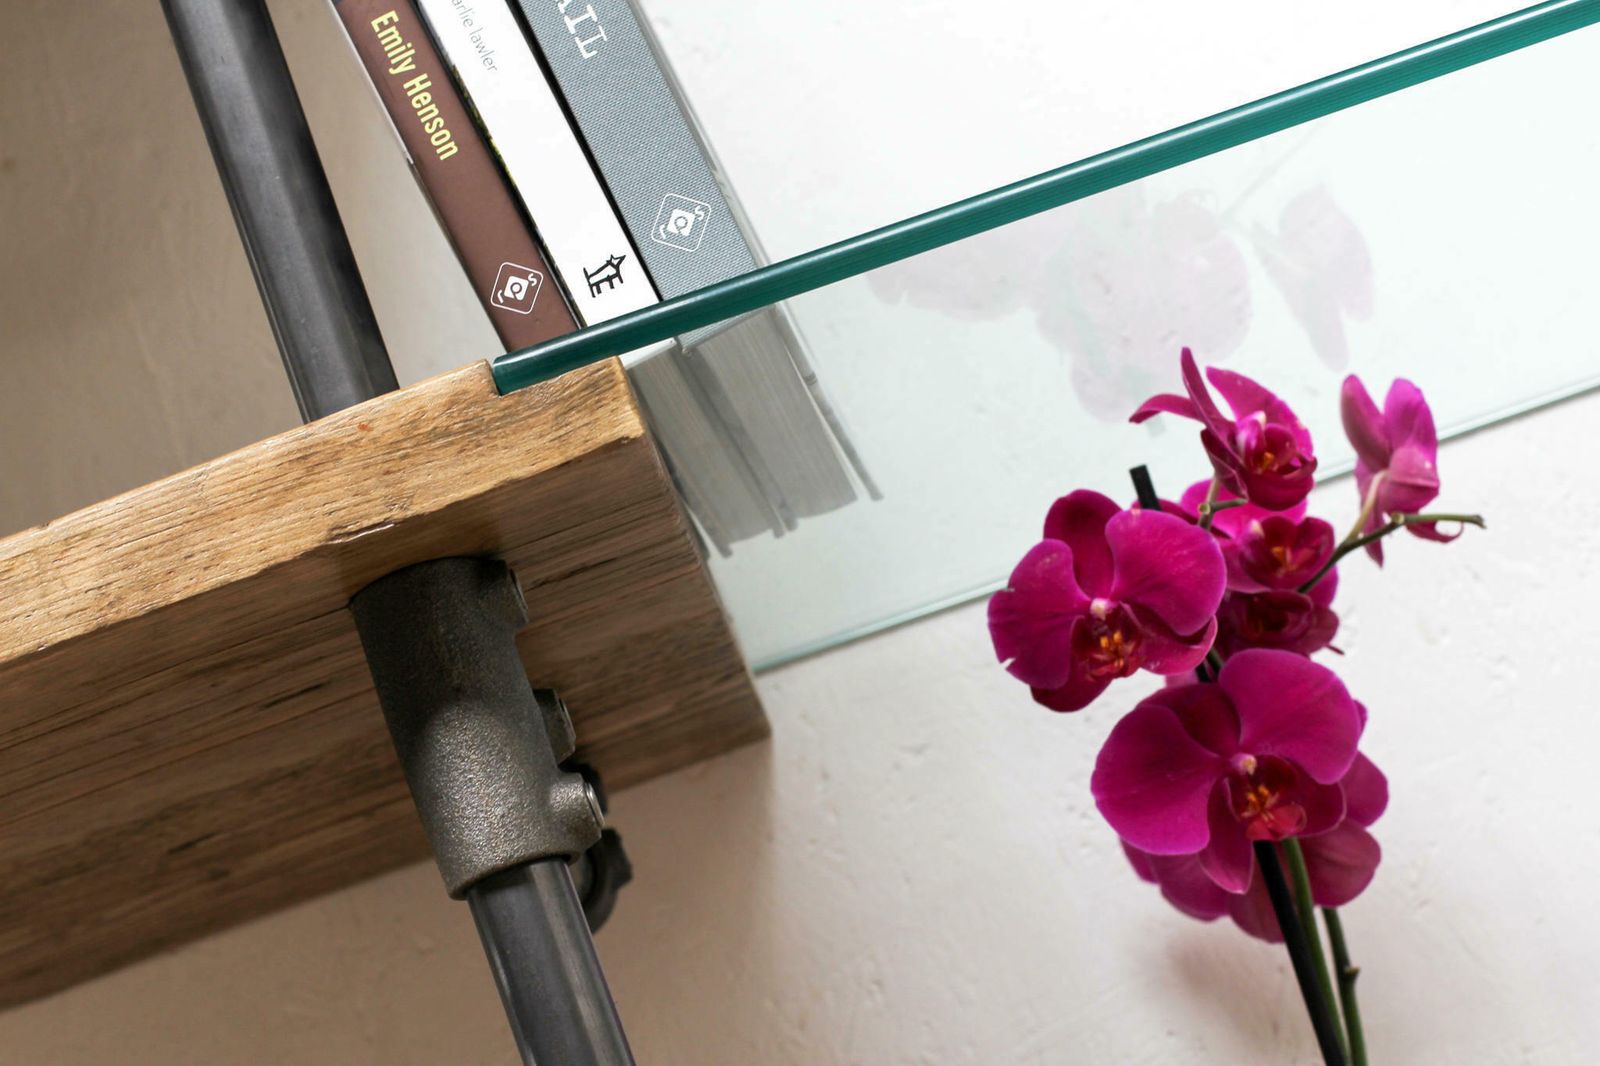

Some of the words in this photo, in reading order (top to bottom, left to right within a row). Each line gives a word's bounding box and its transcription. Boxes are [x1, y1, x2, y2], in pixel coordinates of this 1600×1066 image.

[371, 10, 416, 75] Emily
[403, 73, 458, 160] Henson
[469, 27, 498, 71] lawler
